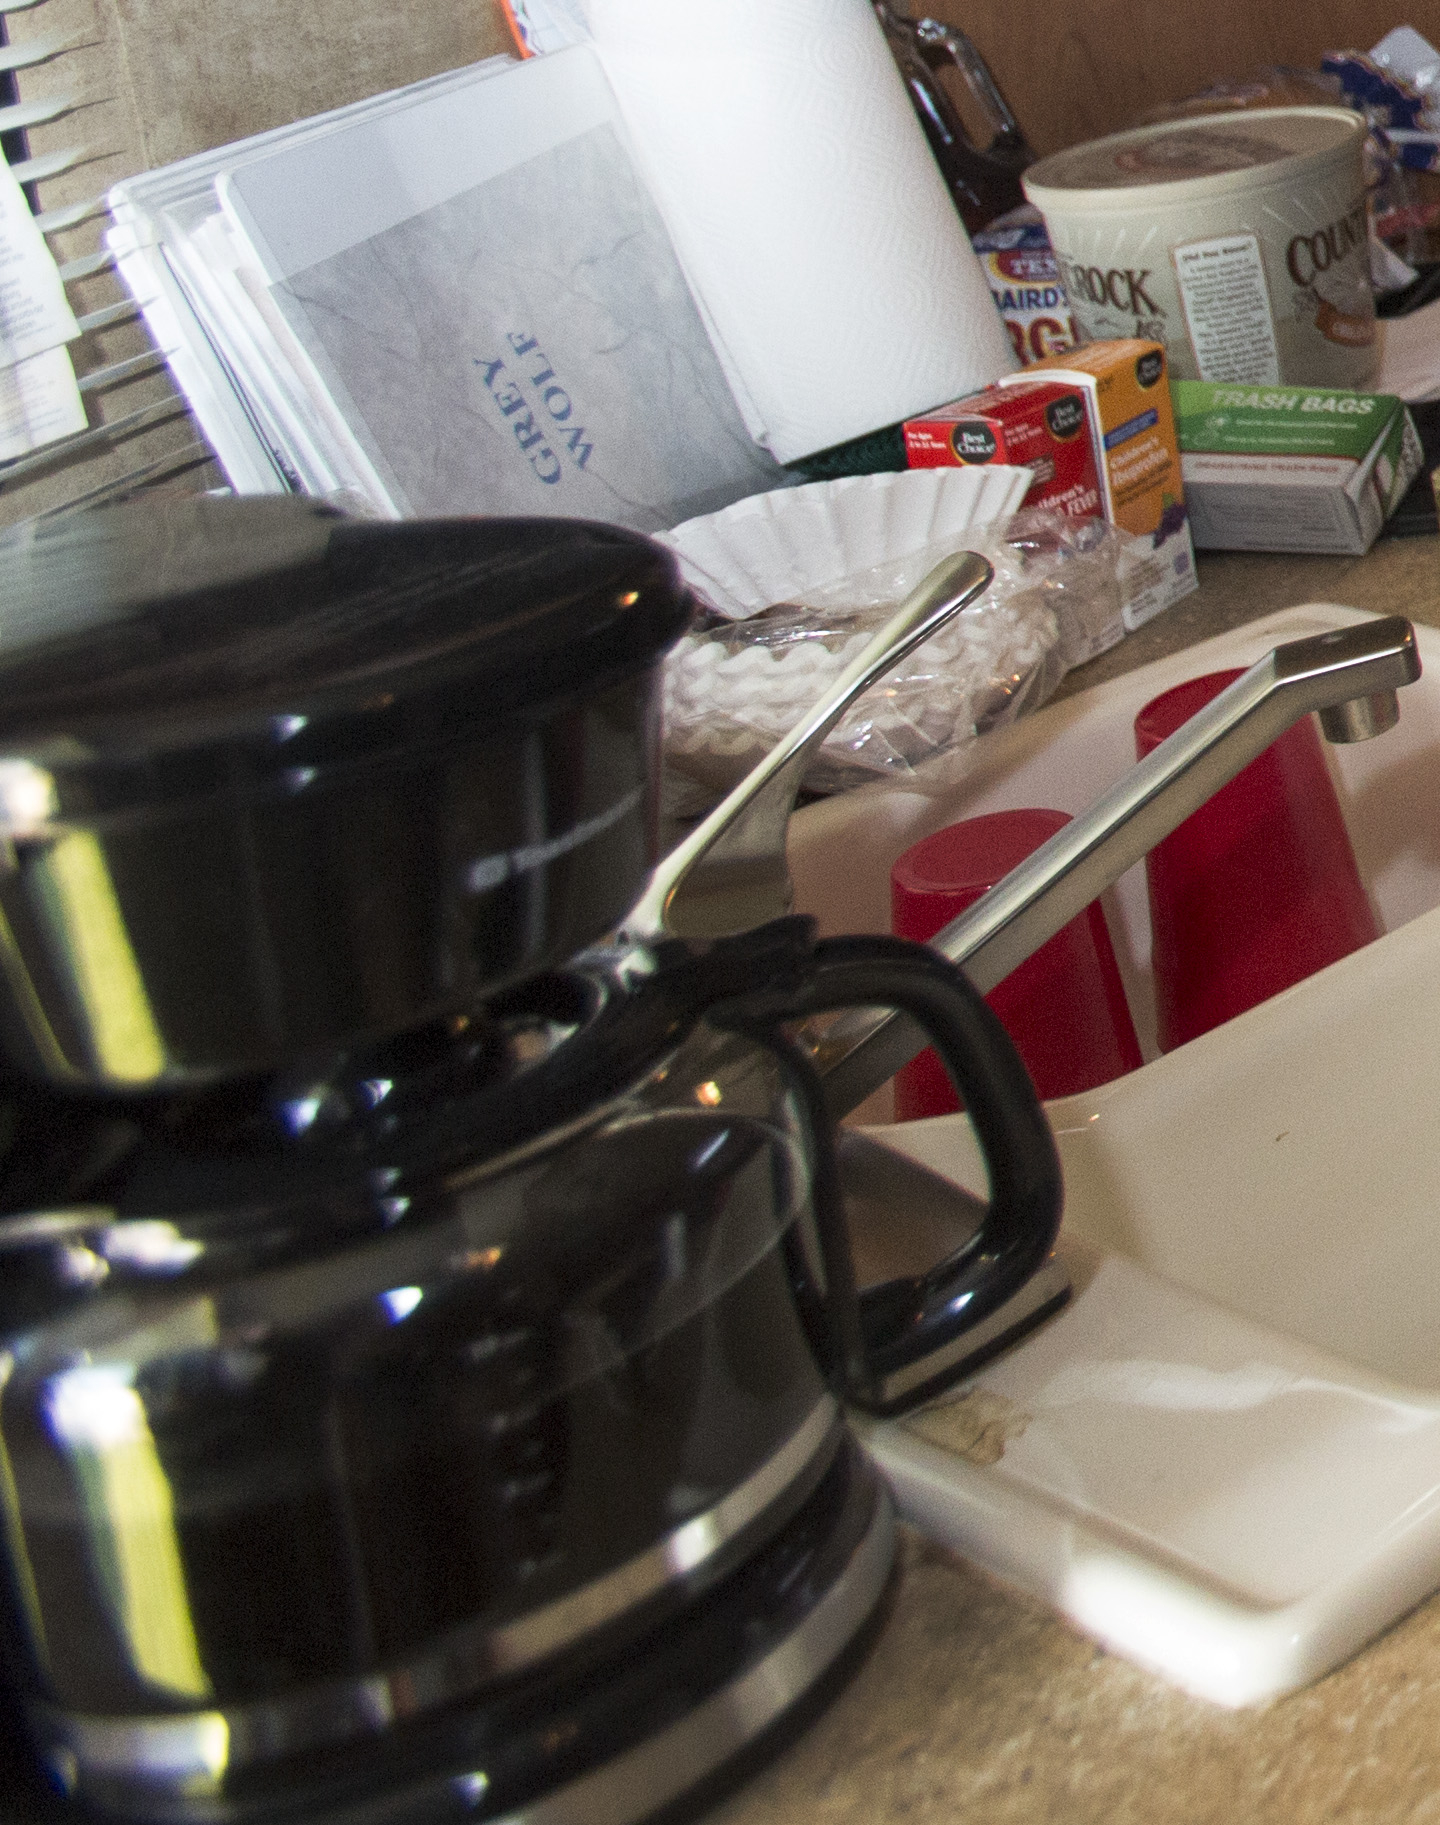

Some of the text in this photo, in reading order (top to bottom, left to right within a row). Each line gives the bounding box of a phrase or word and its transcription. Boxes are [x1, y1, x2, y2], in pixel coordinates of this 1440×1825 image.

[1070, 263, 1168, 319] ROCK
[507, 331, 594, 471] WOLF
[1054, 402, 1075, 418] Best
[1212, 389, 1377, 415] TRASH BAGS
[473, 357, 561, 485] GREY
[955, 440, 996, 454] Choice
[962, 432, 986, 444] Best
[1038, 483, 1085, 509] ildren's
